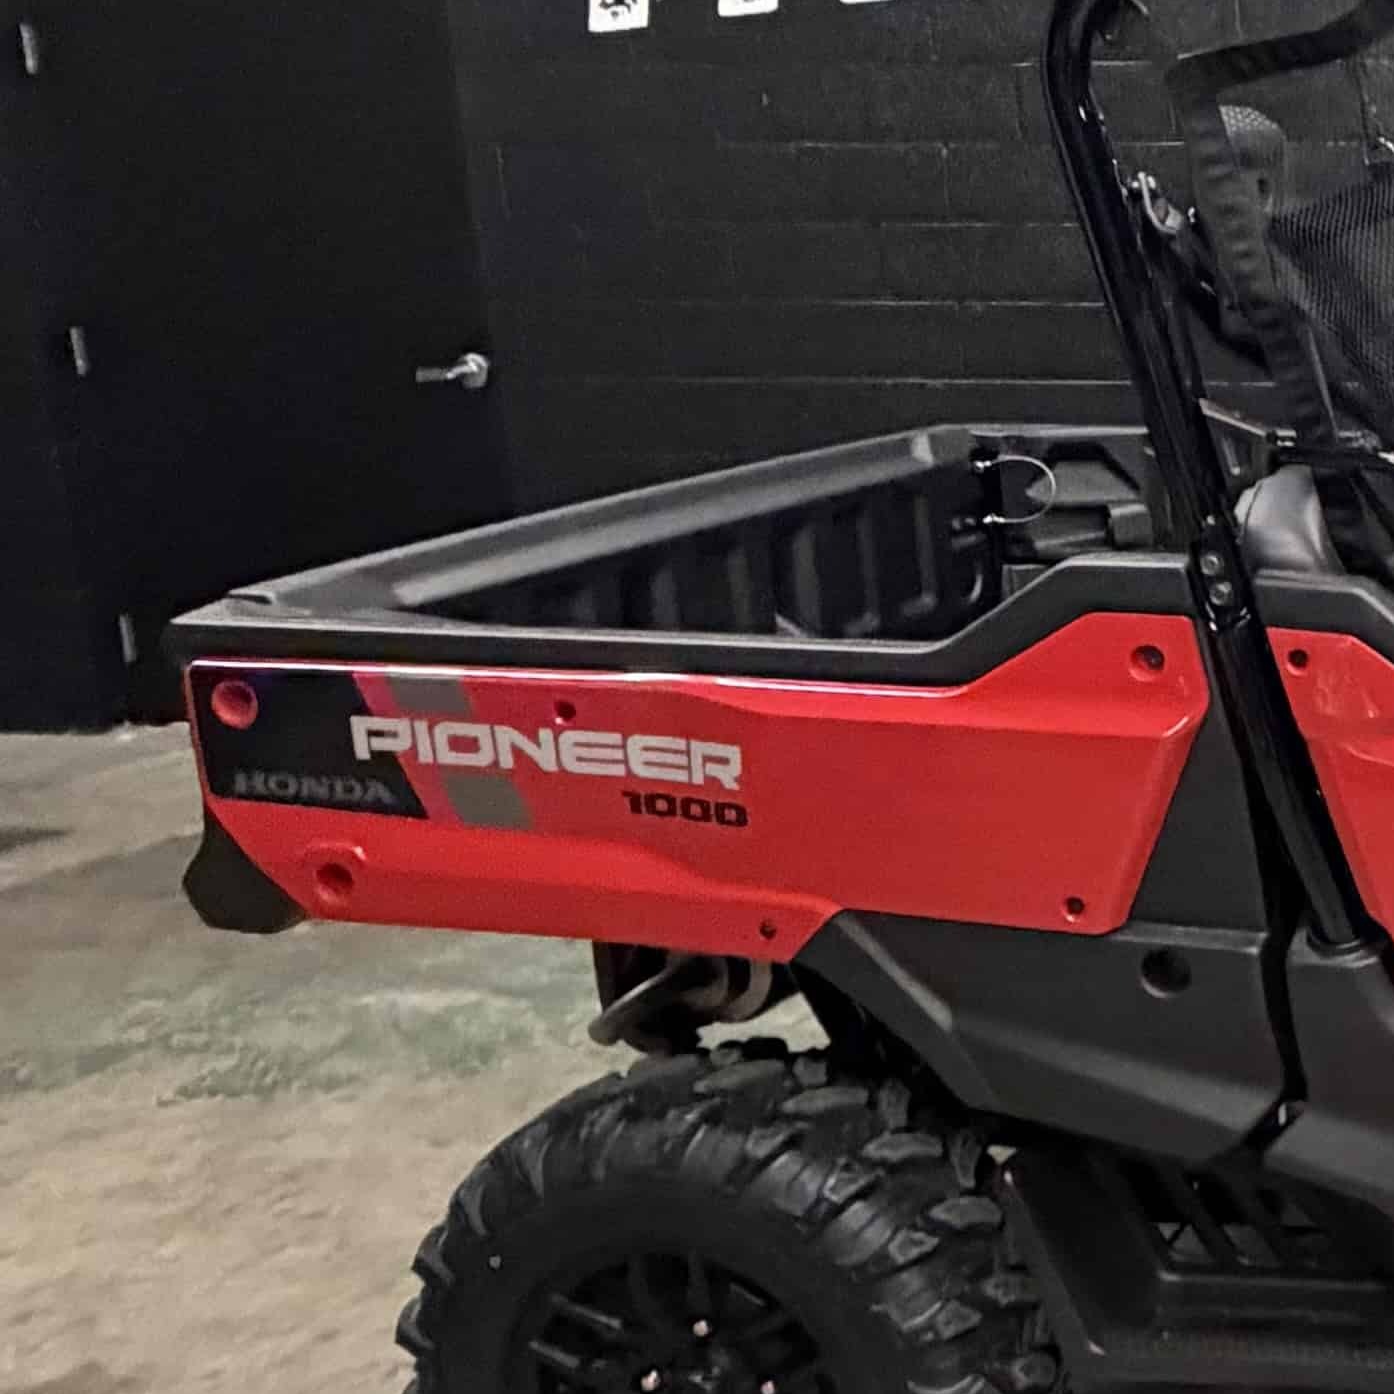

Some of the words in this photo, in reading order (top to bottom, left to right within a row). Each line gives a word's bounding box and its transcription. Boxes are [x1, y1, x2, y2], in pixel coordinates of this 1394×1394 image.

[350, 715, 742, 791] PIONEER
[233, 768, 402, 803] HONDA
[621, 790, 749, 828] 1000
